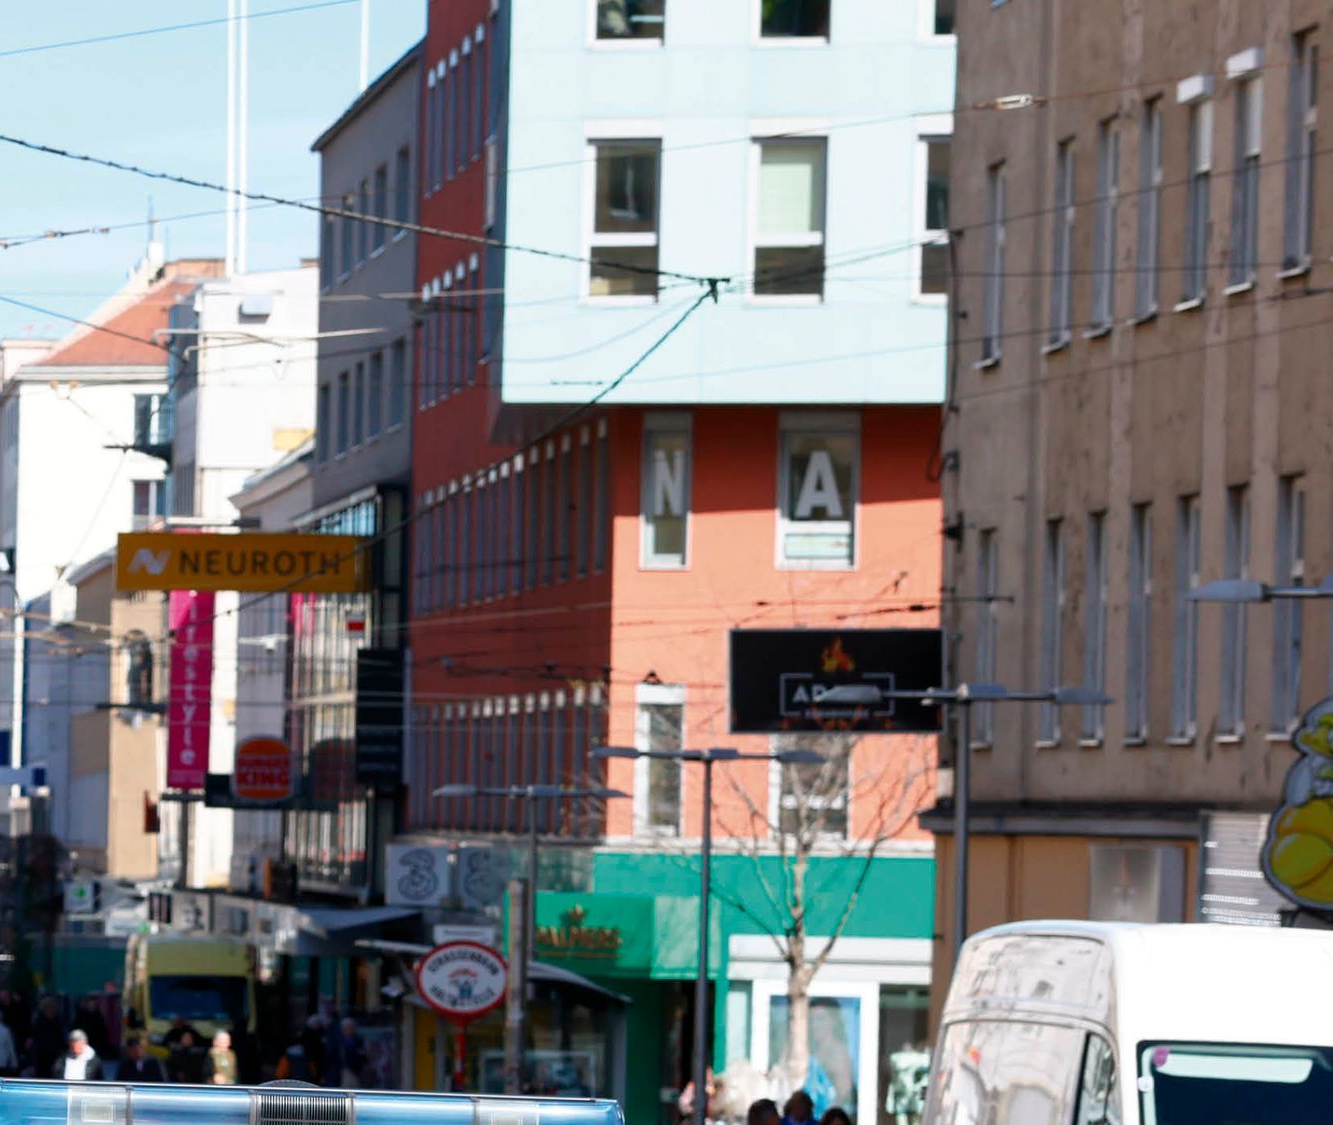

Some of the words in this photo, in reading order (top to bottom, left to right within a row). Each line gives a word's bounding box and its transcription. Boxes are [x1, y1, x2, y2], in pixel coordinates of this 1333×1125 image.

[653, 448, 682, 518] N
[794, 450, 844, 518] A
[179, 549, 341, 576] NEUROTH
